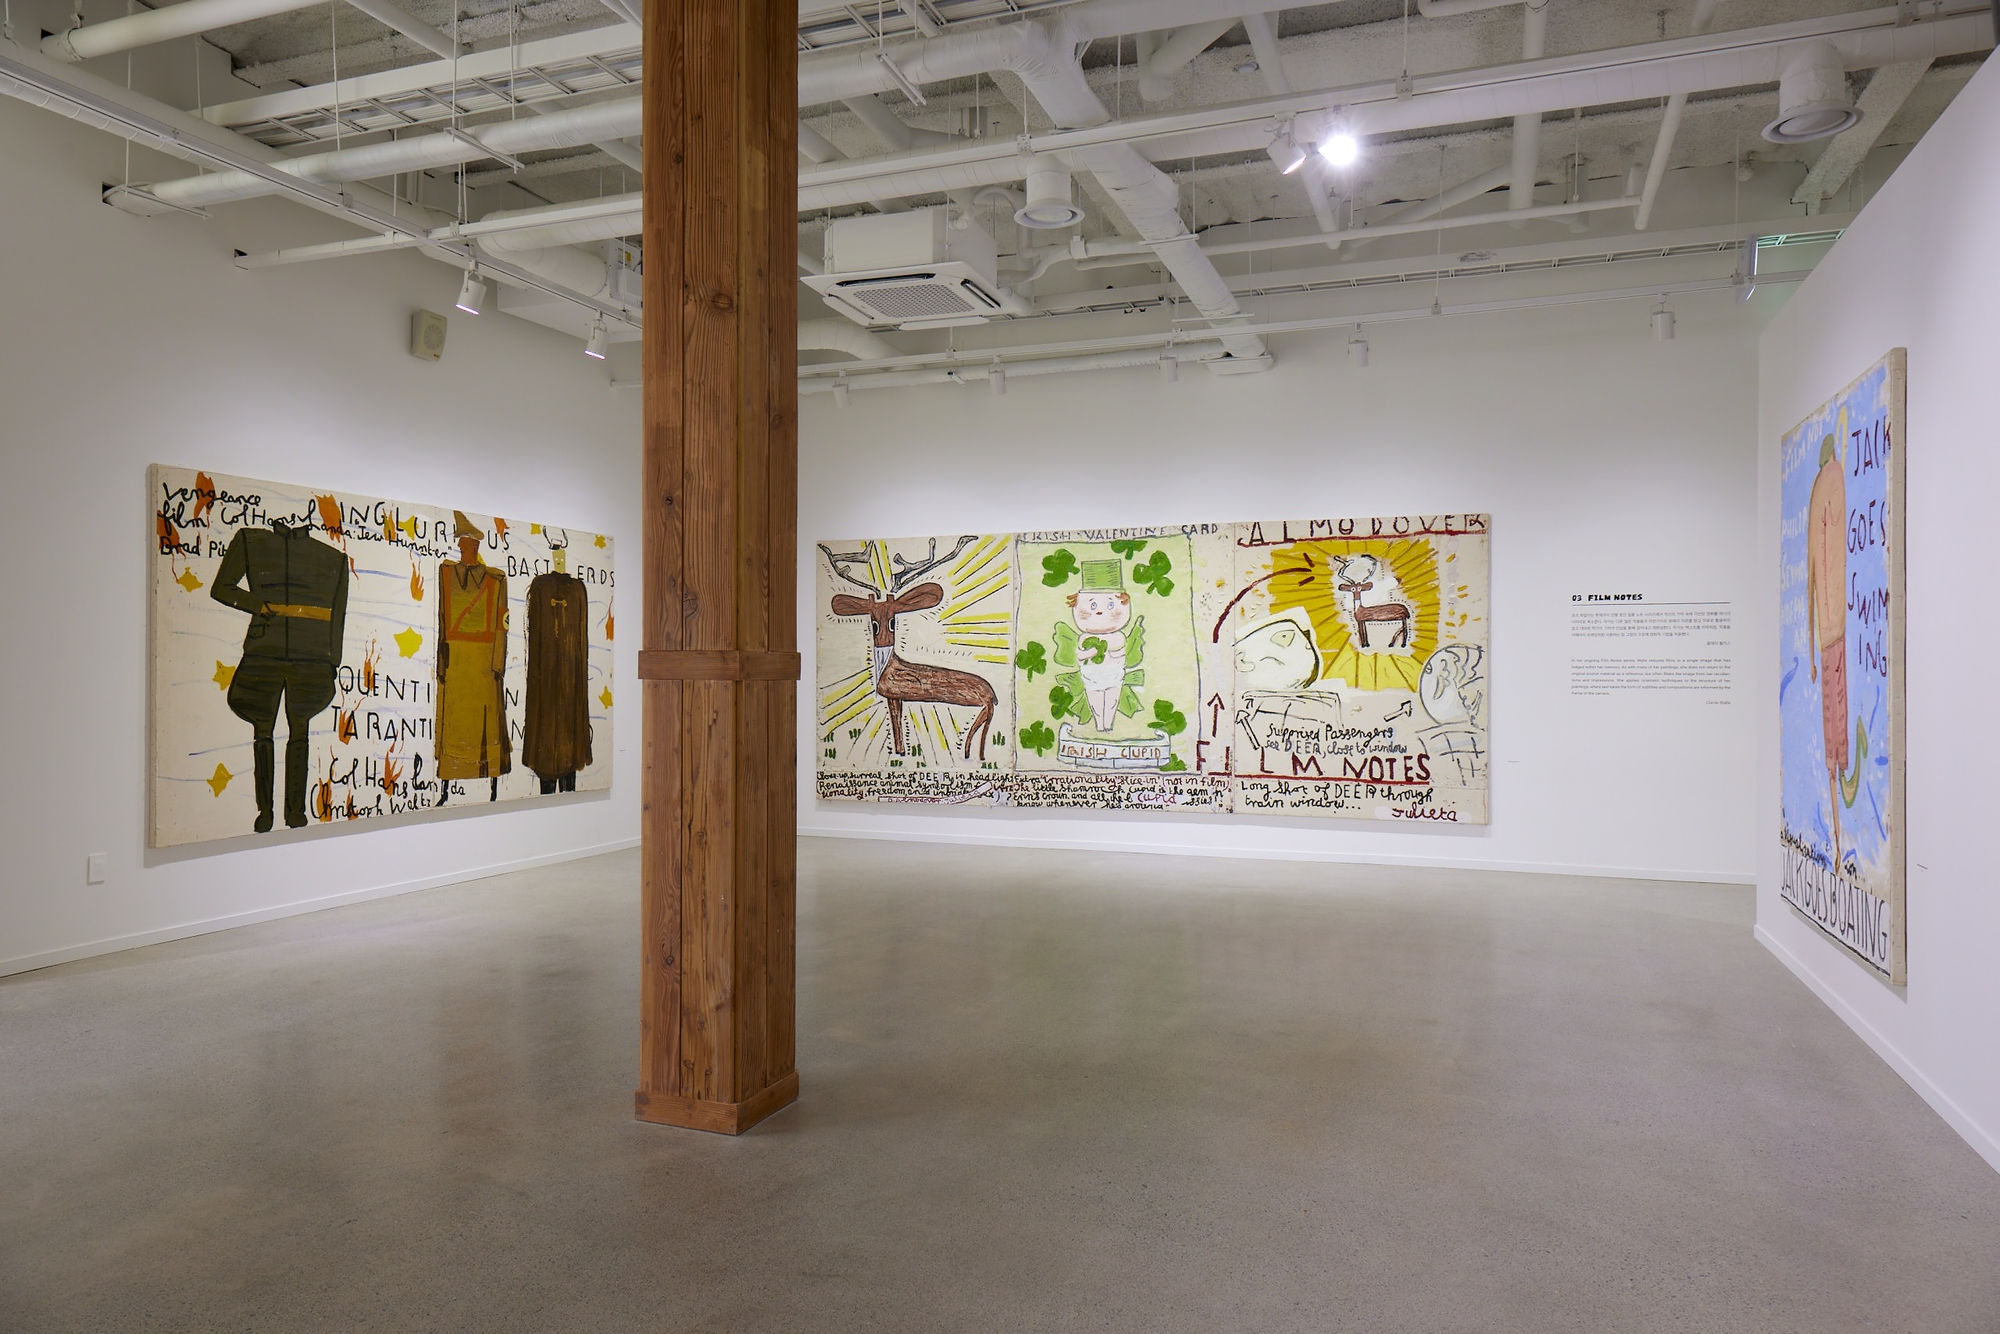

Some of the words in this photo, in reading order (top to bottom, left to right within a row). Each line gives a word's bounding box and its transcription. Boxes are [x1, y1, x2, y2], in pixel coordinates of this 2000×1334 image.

[162, 481, 261, 510] Vengeance
[1181, 522, 1218, 535] CARD
[1846, 499, 1886, 553] GOES
[159, 535, 201, 556] Brad
[1571, 594, 1583, 602] 03
[1587, 594, 1611, 602] FILM
[1613, 593, 1644, 601] NOTES
[1061, 744, 1107, 758] IRISH
[1121, 747, 1160, 760] CUPID
[1342, 752, 1432, 782] NOTES
[1240, 781, 1273, 803] Long
[1313, 782, 1332, 802] of
[1334, 783, 1378, 801] DEER
[1379, 785, 1434, 805] through
[1244, 794, 1286, 808] train
